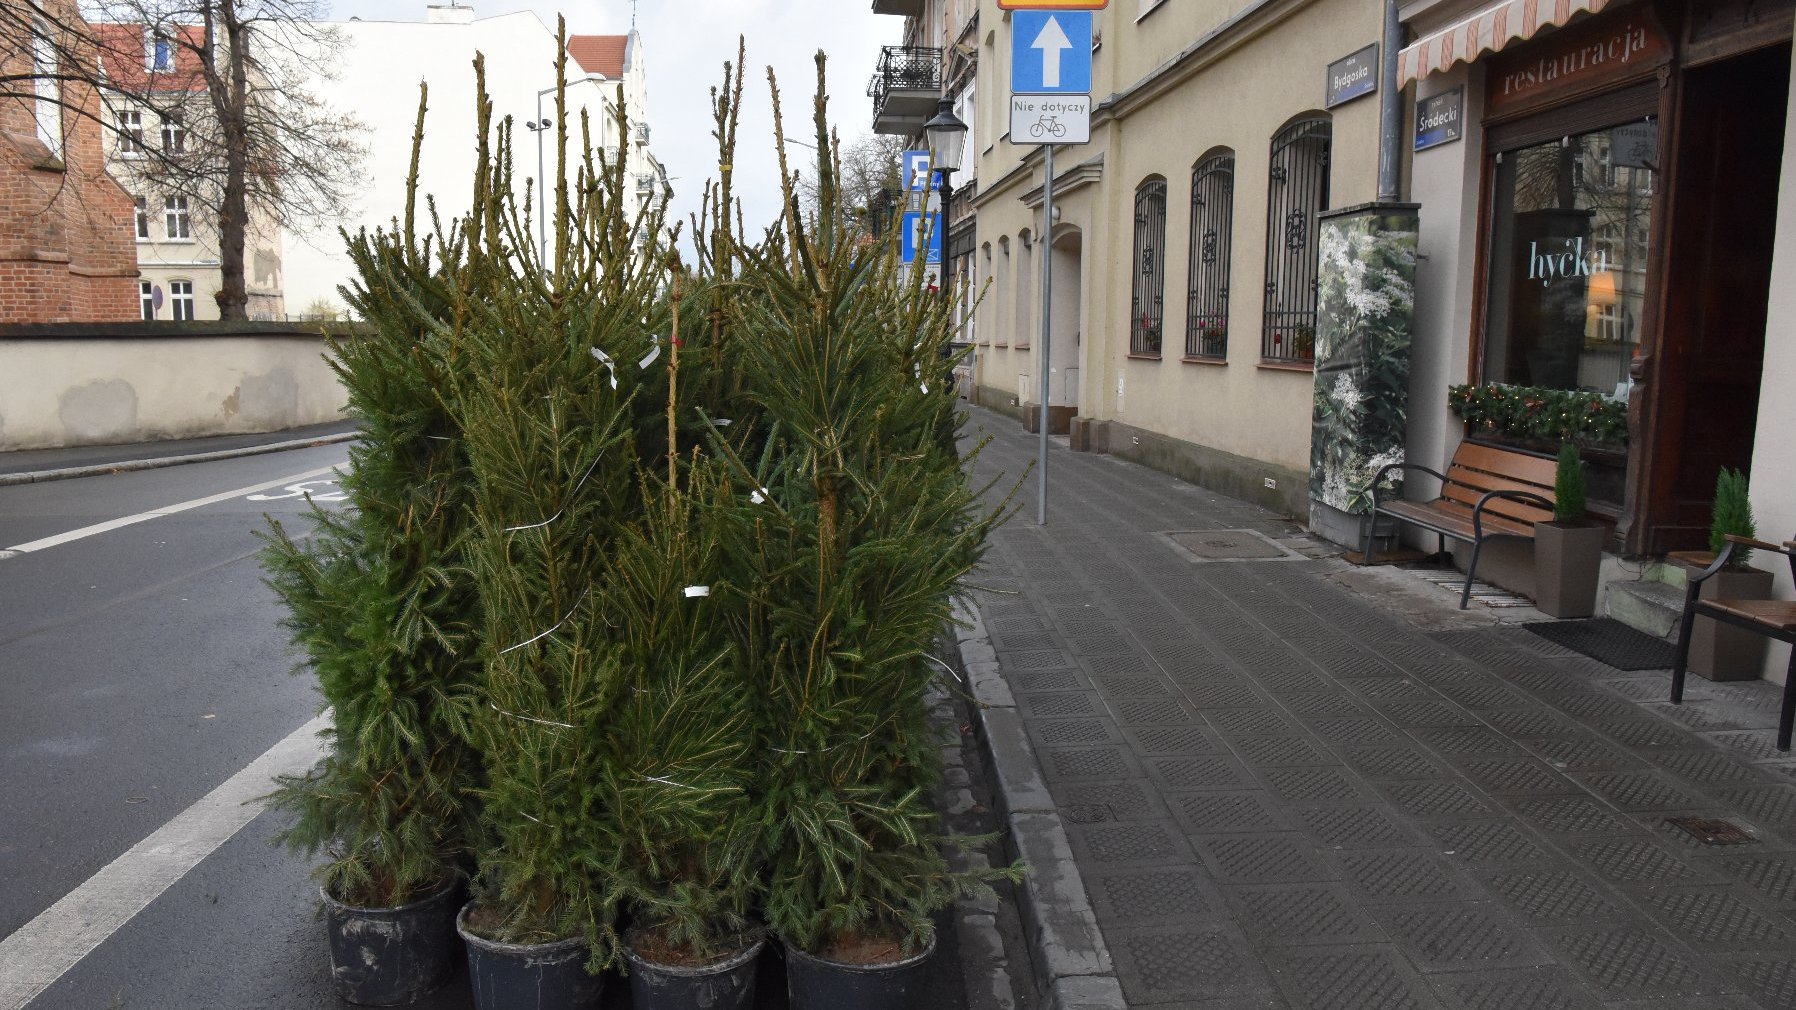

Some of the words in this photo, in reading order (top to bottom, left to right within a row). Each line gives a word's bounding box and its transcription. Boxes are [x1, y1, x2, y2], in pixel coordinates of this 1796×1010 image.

[1504, 24, 1647, 95] restauracja
[1334, 65, 1368, 91] Bydgoska
[1014, 101, 1034, 112] Nie
[1041, 101, 1085, 115] dotyczy
[1419, 104, 1457, 132] Śródecki
